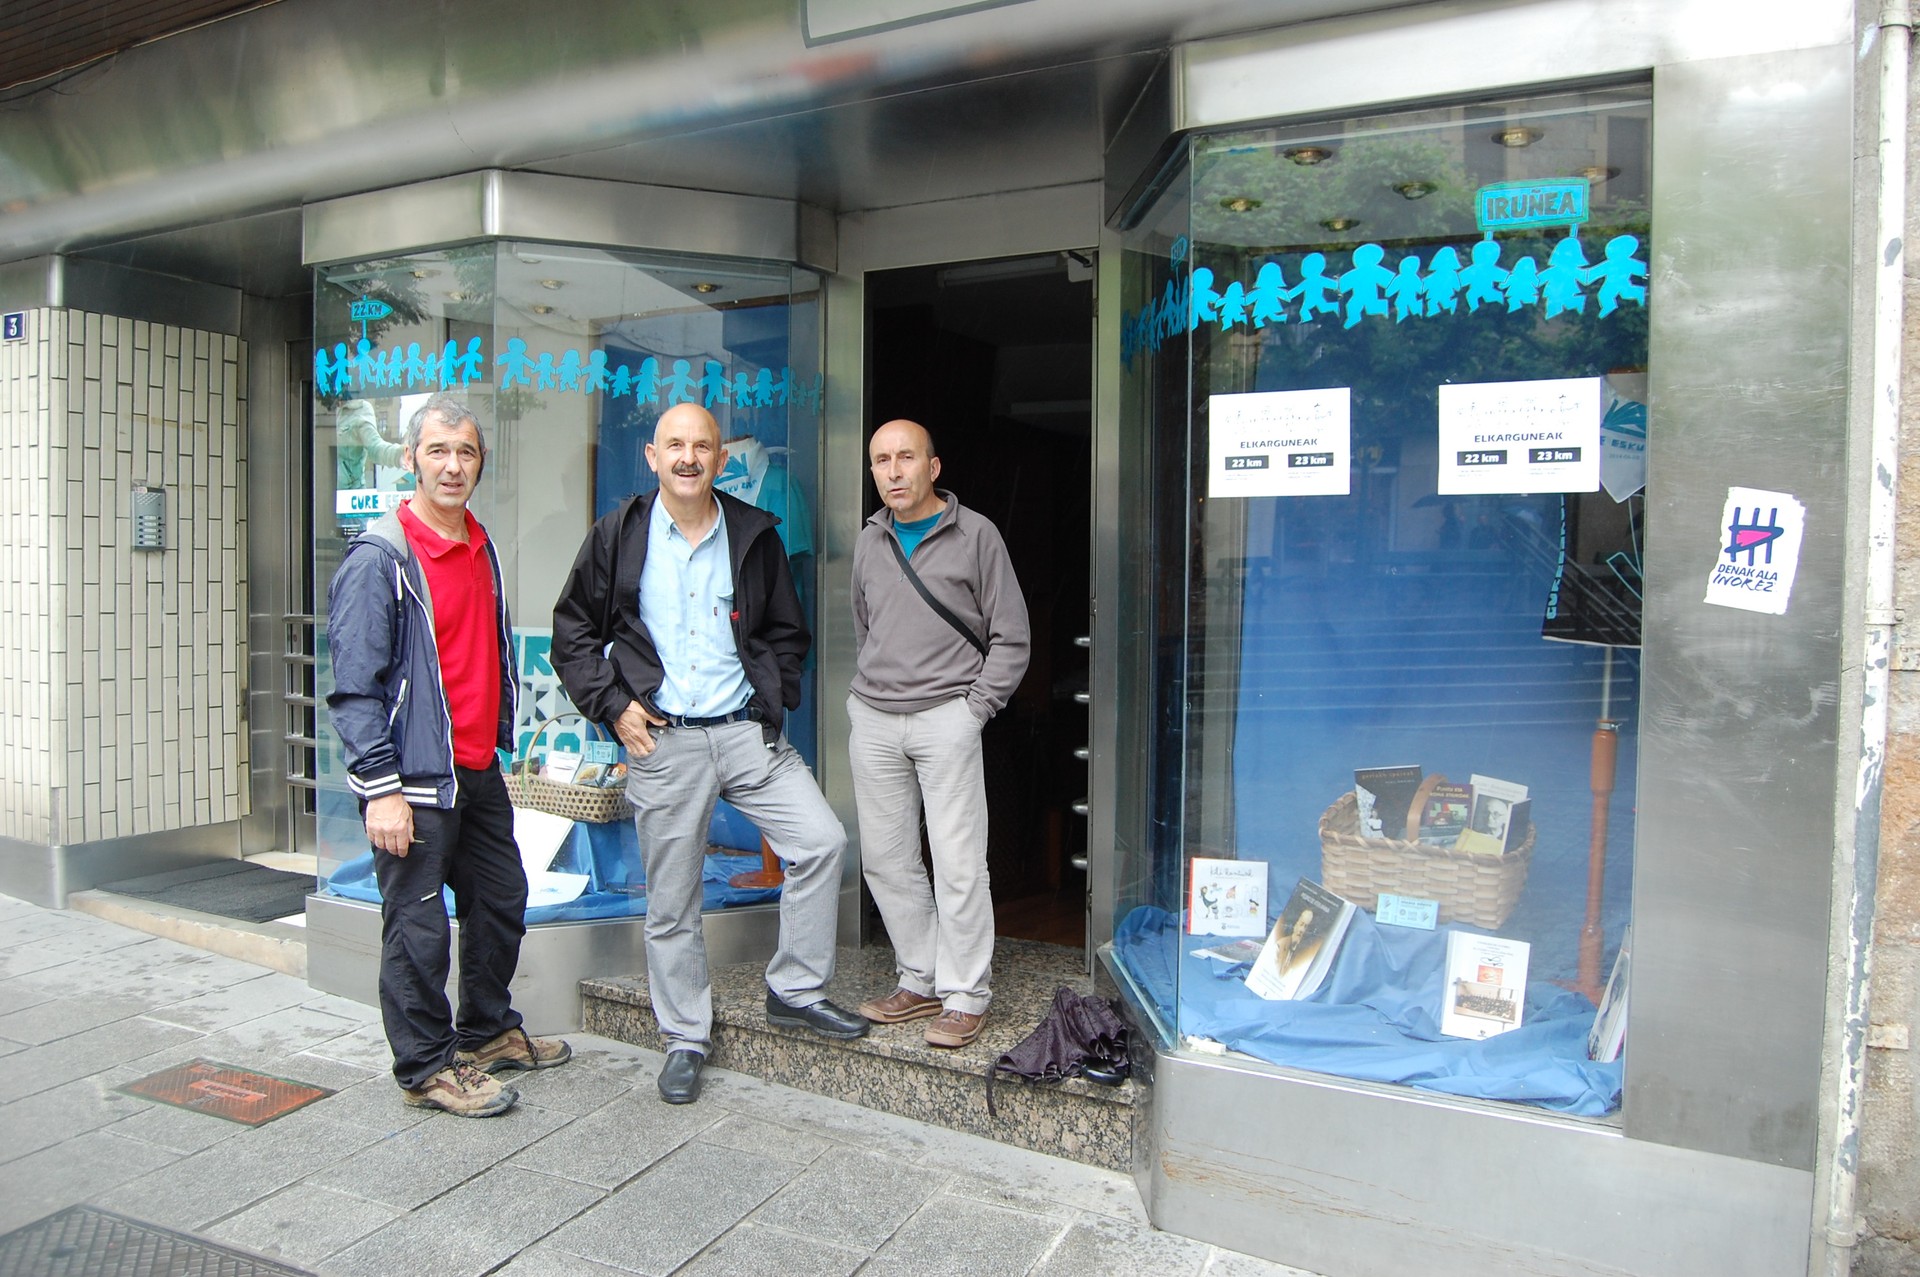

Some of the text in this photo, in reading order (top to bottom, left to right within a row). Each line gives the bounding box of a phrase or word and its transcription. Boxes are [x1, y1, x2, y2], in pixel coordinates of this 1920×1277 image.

[1487, 189, 1577, 220] IRUÑEA
[10, 317, 18, 337] 3
[1474, 431, 1563, 443] ELKARGUNEAK
[1240, 438, 1318, 449] ELKARGUNEAK
[1294, 455, 1327, 466] 23 km
[1464, 453, 1500, 464] 22 km
[1536, 450, 1573, 461] 23 km
[1231, 458, 1262, 468] 22 km
[1717, 563, 1778, 581] DENAK ALA
